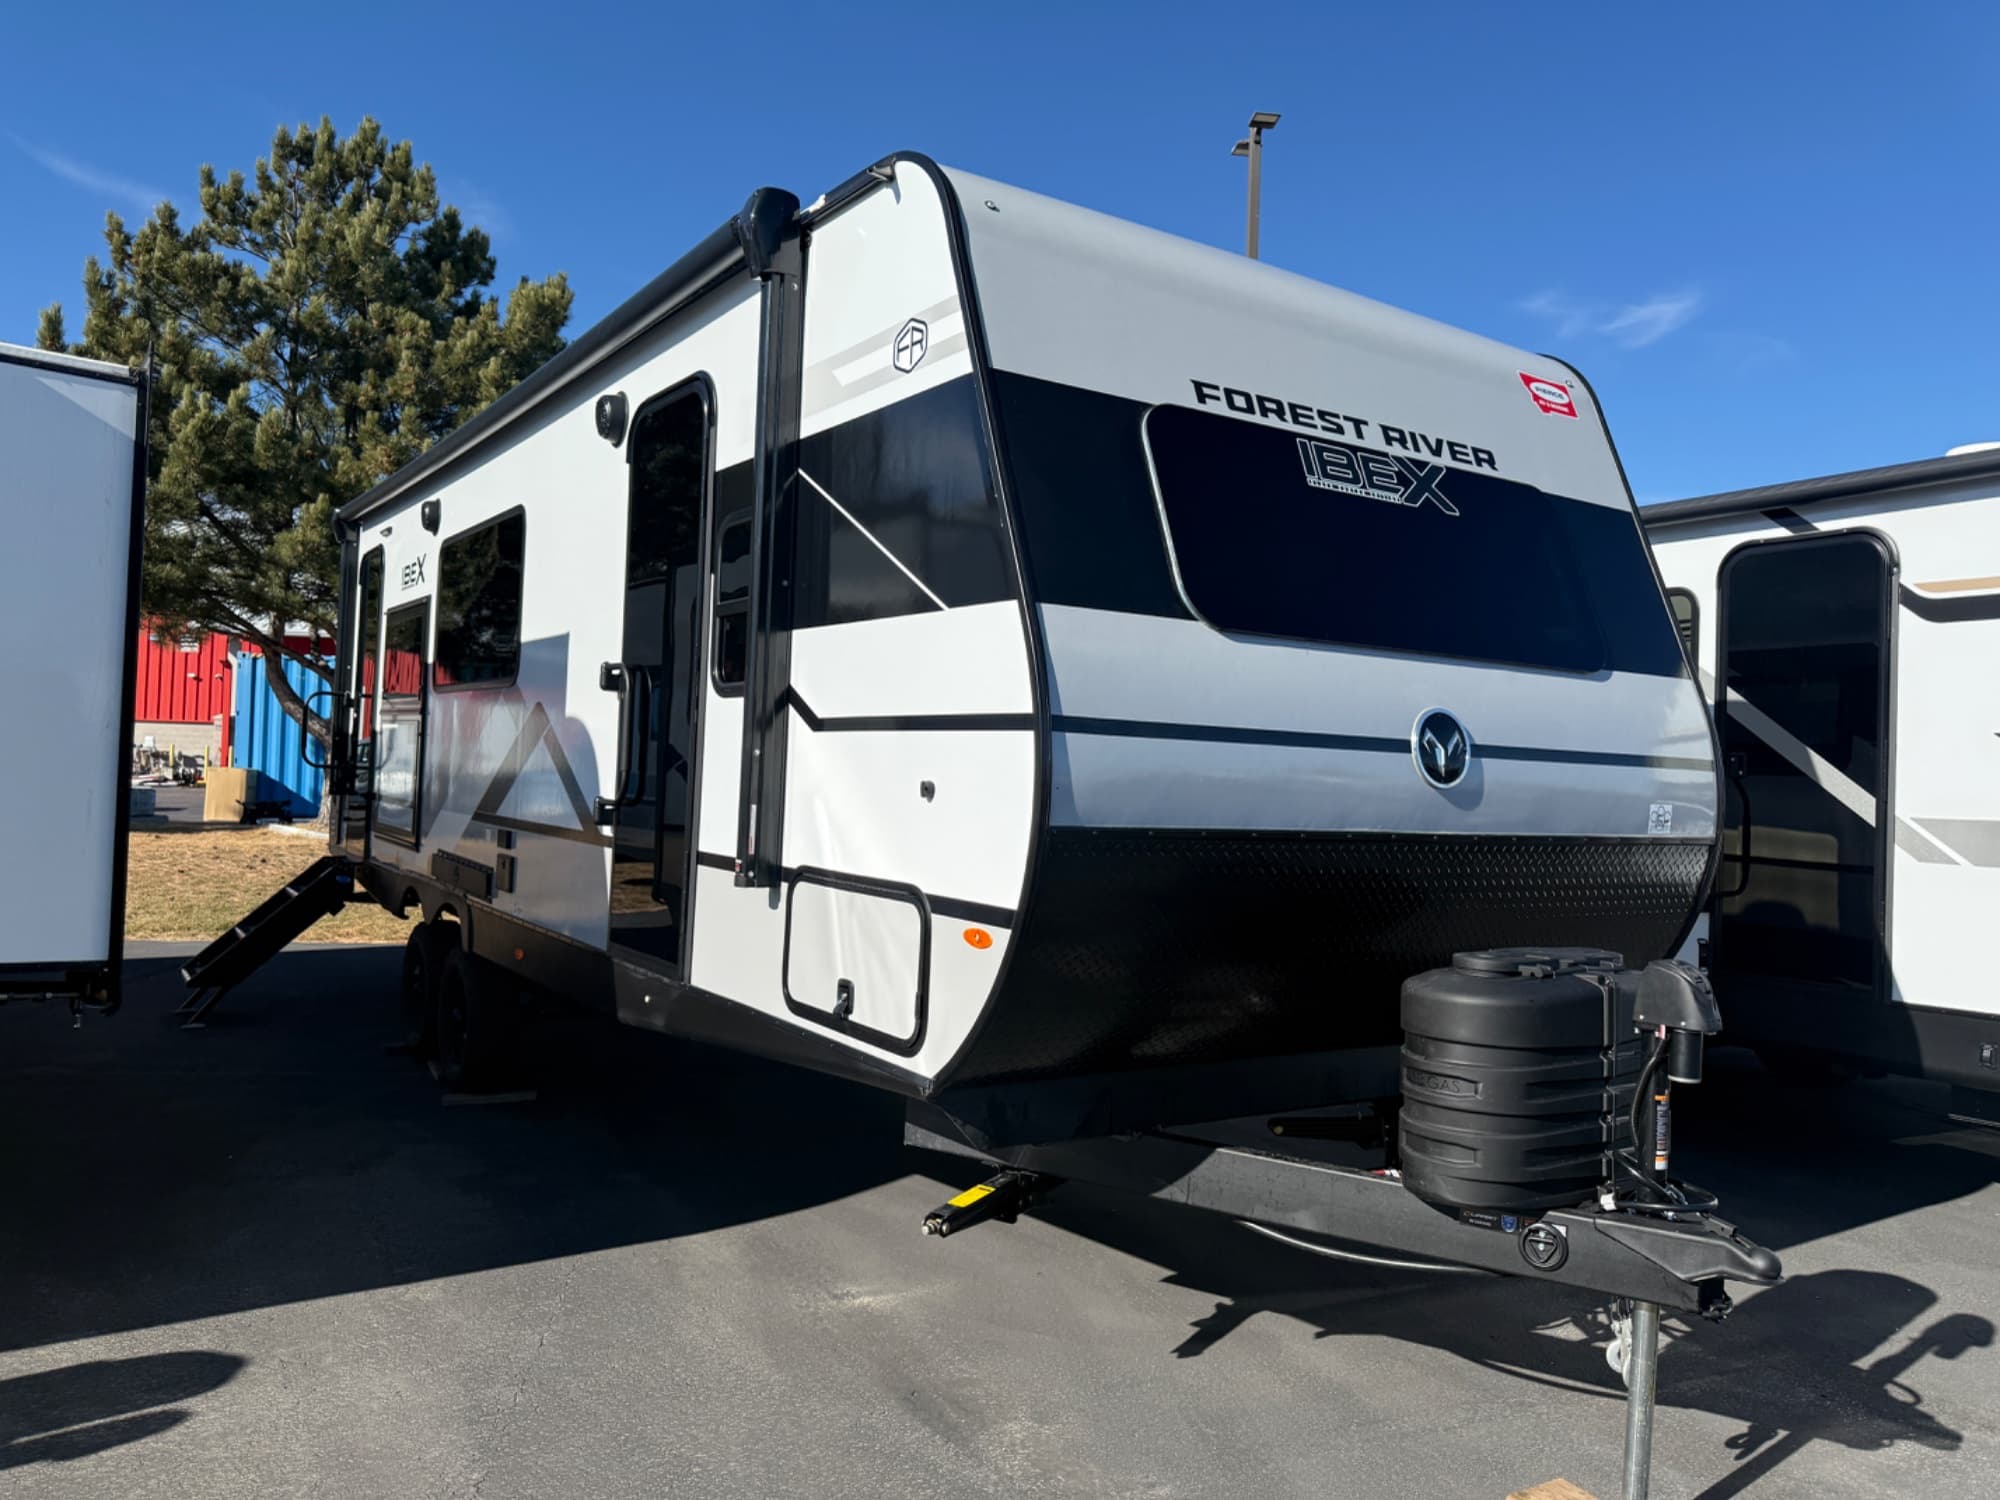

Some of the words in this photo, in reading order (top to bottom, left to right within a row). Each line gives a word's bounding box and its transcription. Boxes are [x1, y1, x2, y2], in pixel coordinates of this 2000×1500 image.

[1189, 378, 1369, 440] FOREST
[1378, 423, 1499, 471] RIVER
[1296, 437, 1461, 516] IBEX
[401, 552, 427, 588] IBEX
